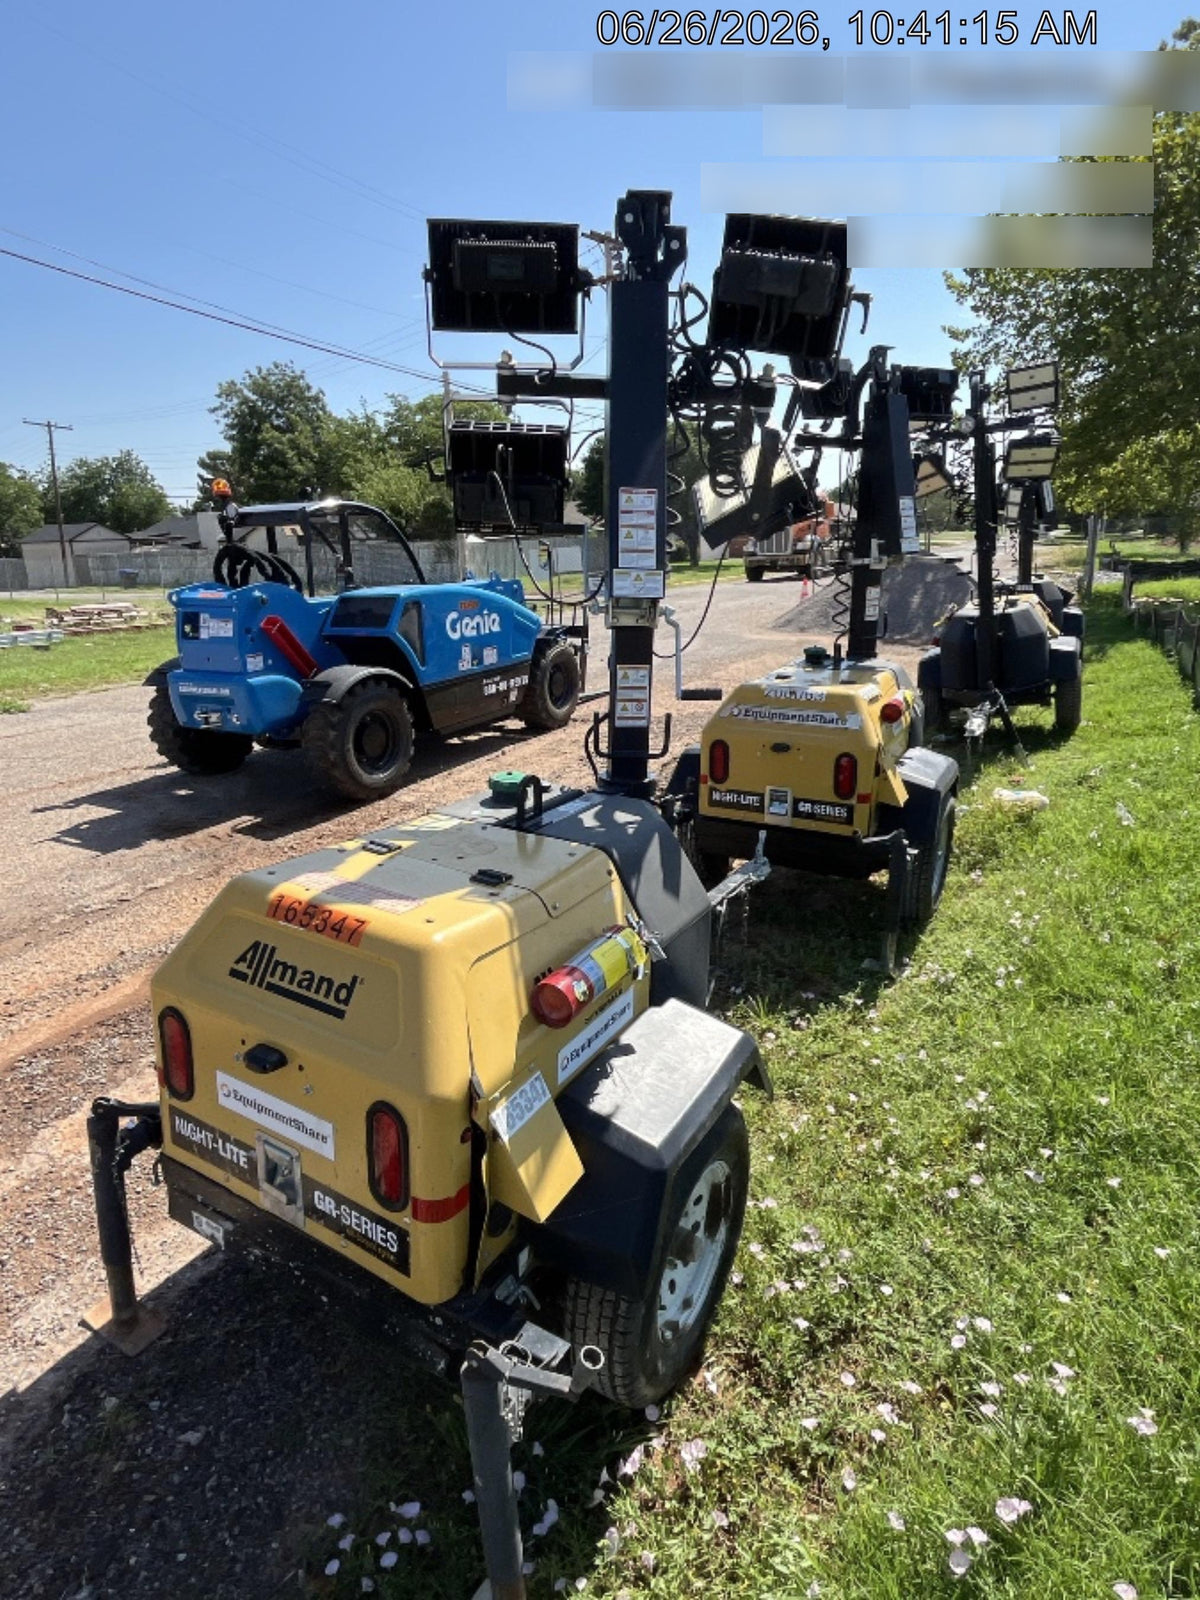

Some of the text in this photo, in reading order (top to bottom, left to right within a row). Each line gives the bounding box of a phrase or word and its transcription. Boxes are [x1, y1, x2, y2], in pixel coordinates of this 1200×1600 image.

[445, 608, 501, 640] Genie
[271, 893, 366, 944] 165347
[233, 940, 360, 1008] Allmand
[174, 1115, 249, 1169] NIGHT-LITE
[232, 1088, 329, 1145] EquipmentShare
[313, 1190, 399, 1253] GR-SERIES
